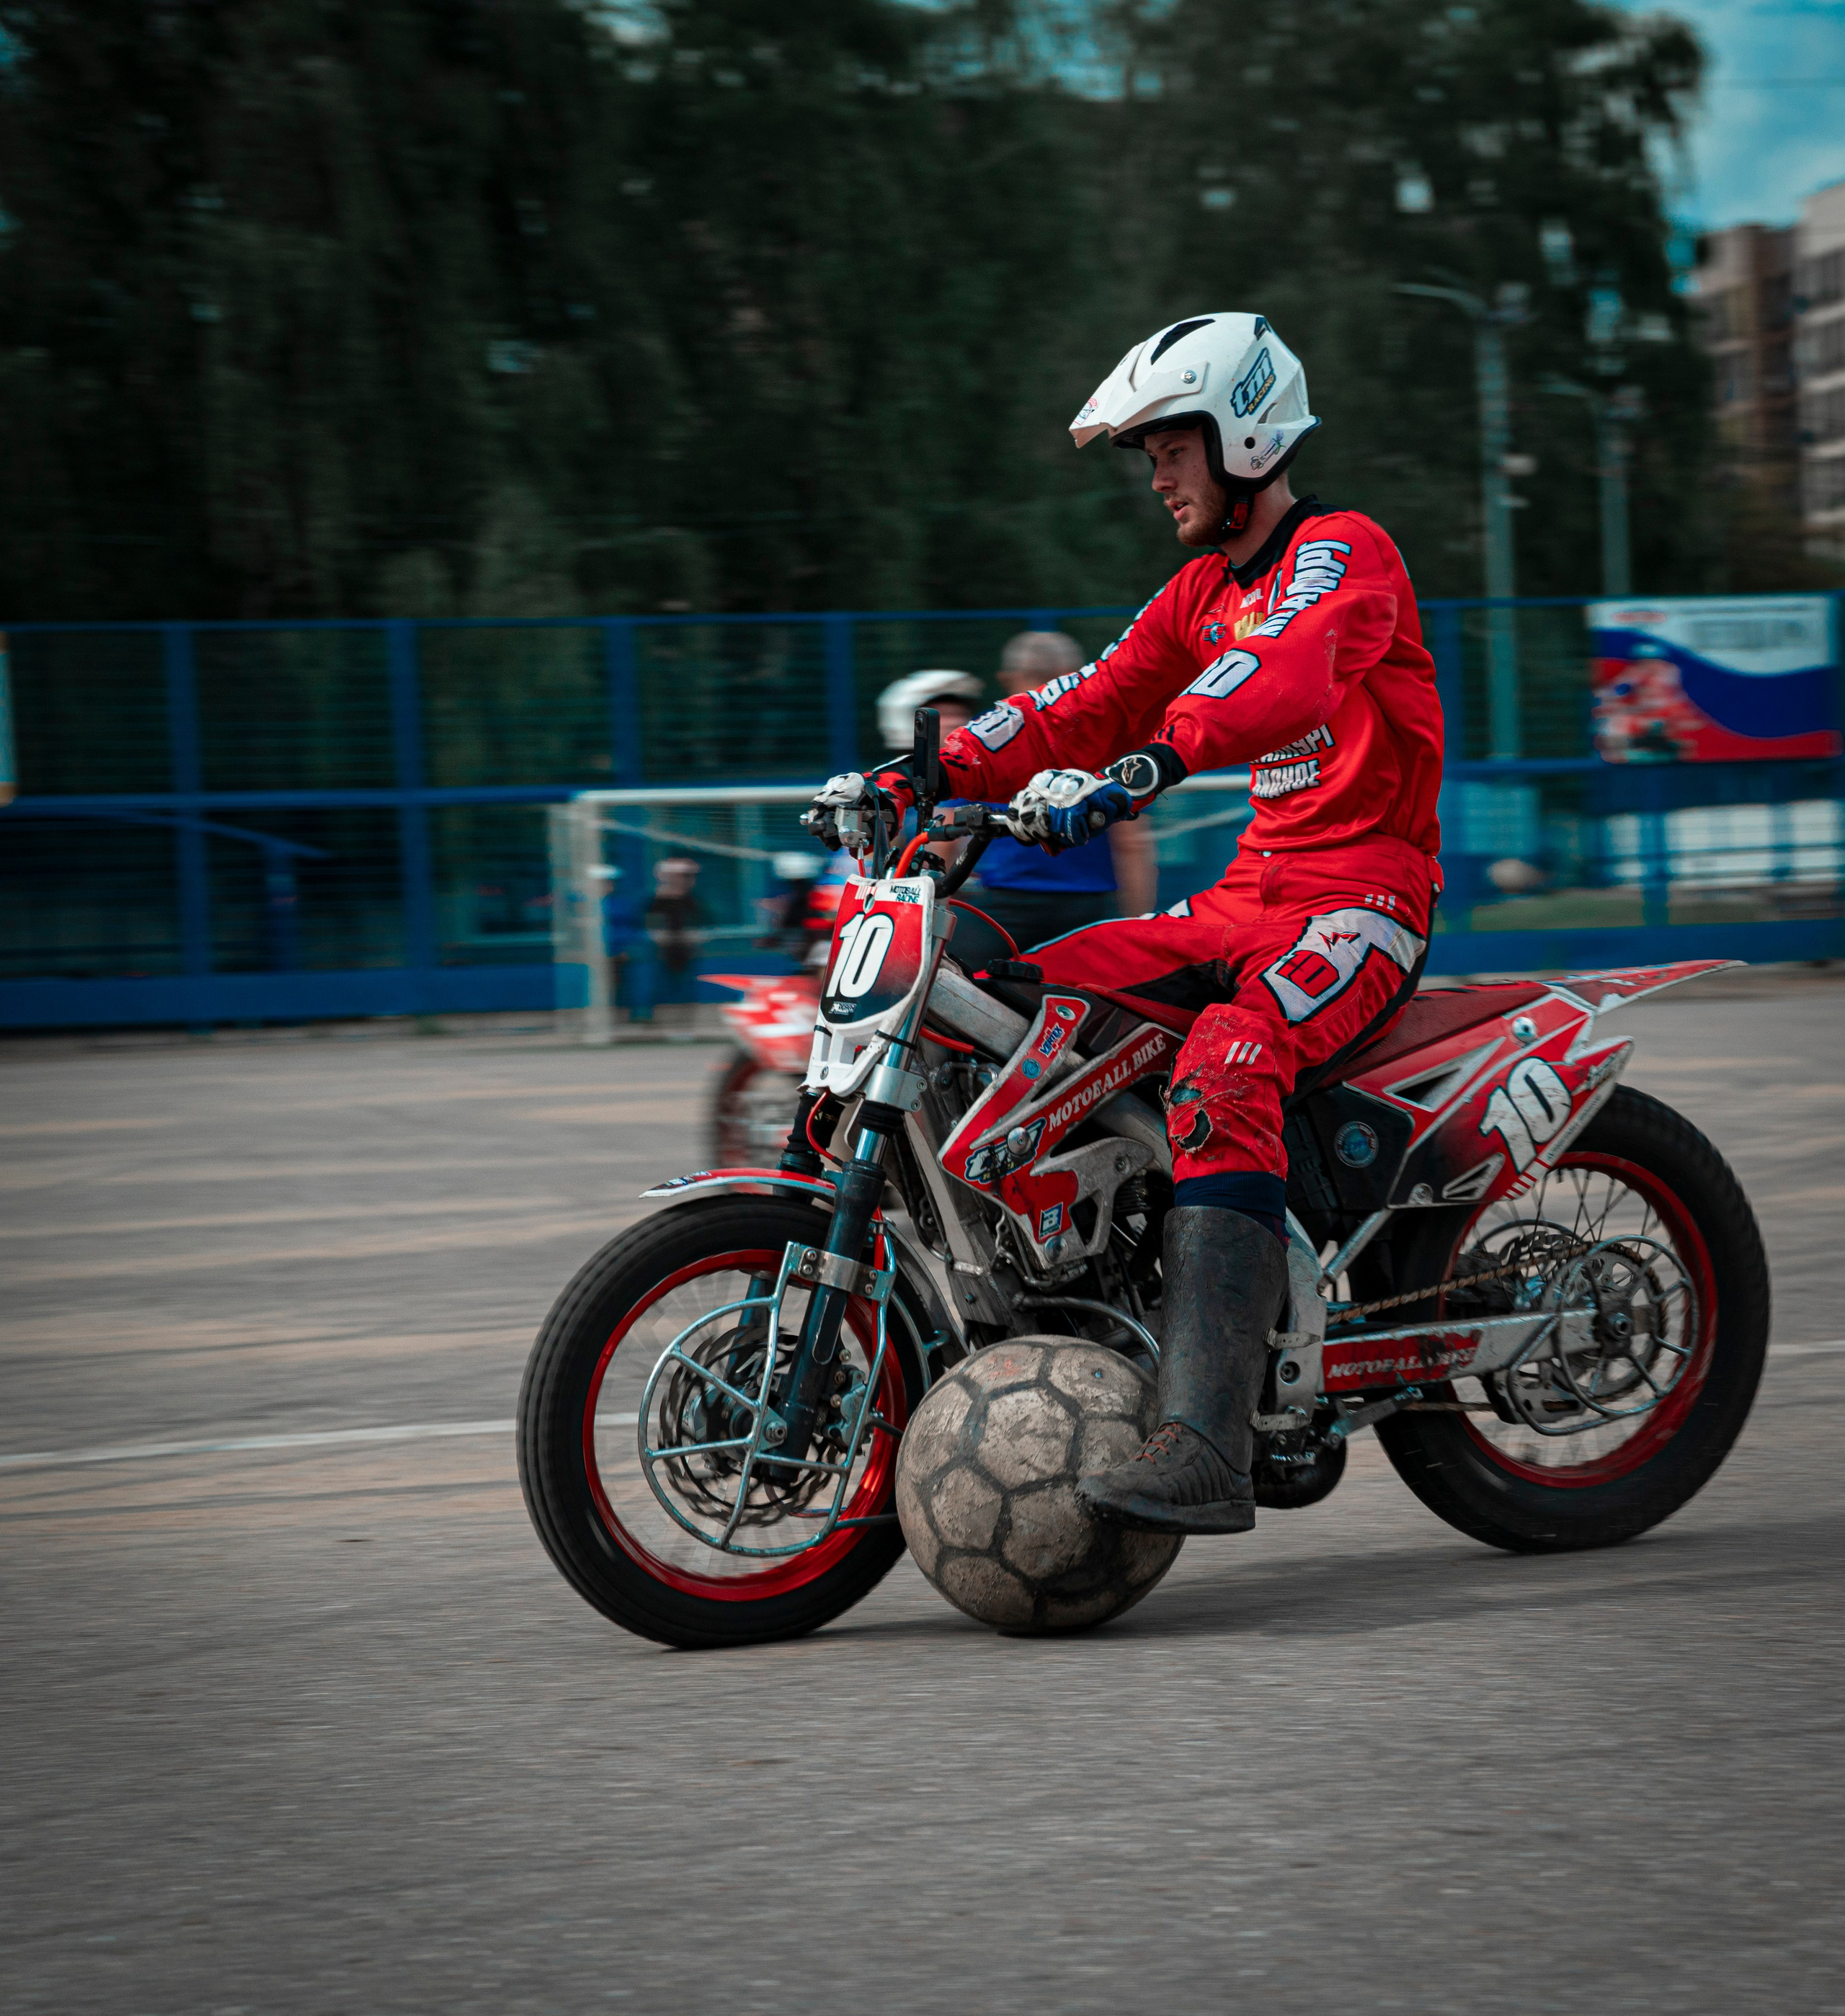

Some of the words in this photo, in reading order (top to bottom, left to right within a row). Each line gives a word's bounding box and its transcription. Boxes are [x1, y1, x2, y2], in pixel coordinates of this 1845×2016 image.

[1248, 374, 1275, 414] RACING
[889, 885, 922, 896] MOTOBALL
[895, 894, 920, 904] RACING
[825, 911, 895, 999] 10
[1039, 1025, 1064, 1057] VERTEX
[1047, 1058, 1133, 1132] MOTOBALL
[1132, 1033, 1167, 1071] BIKE
[1479, 1056, 1573, 1174] 10
